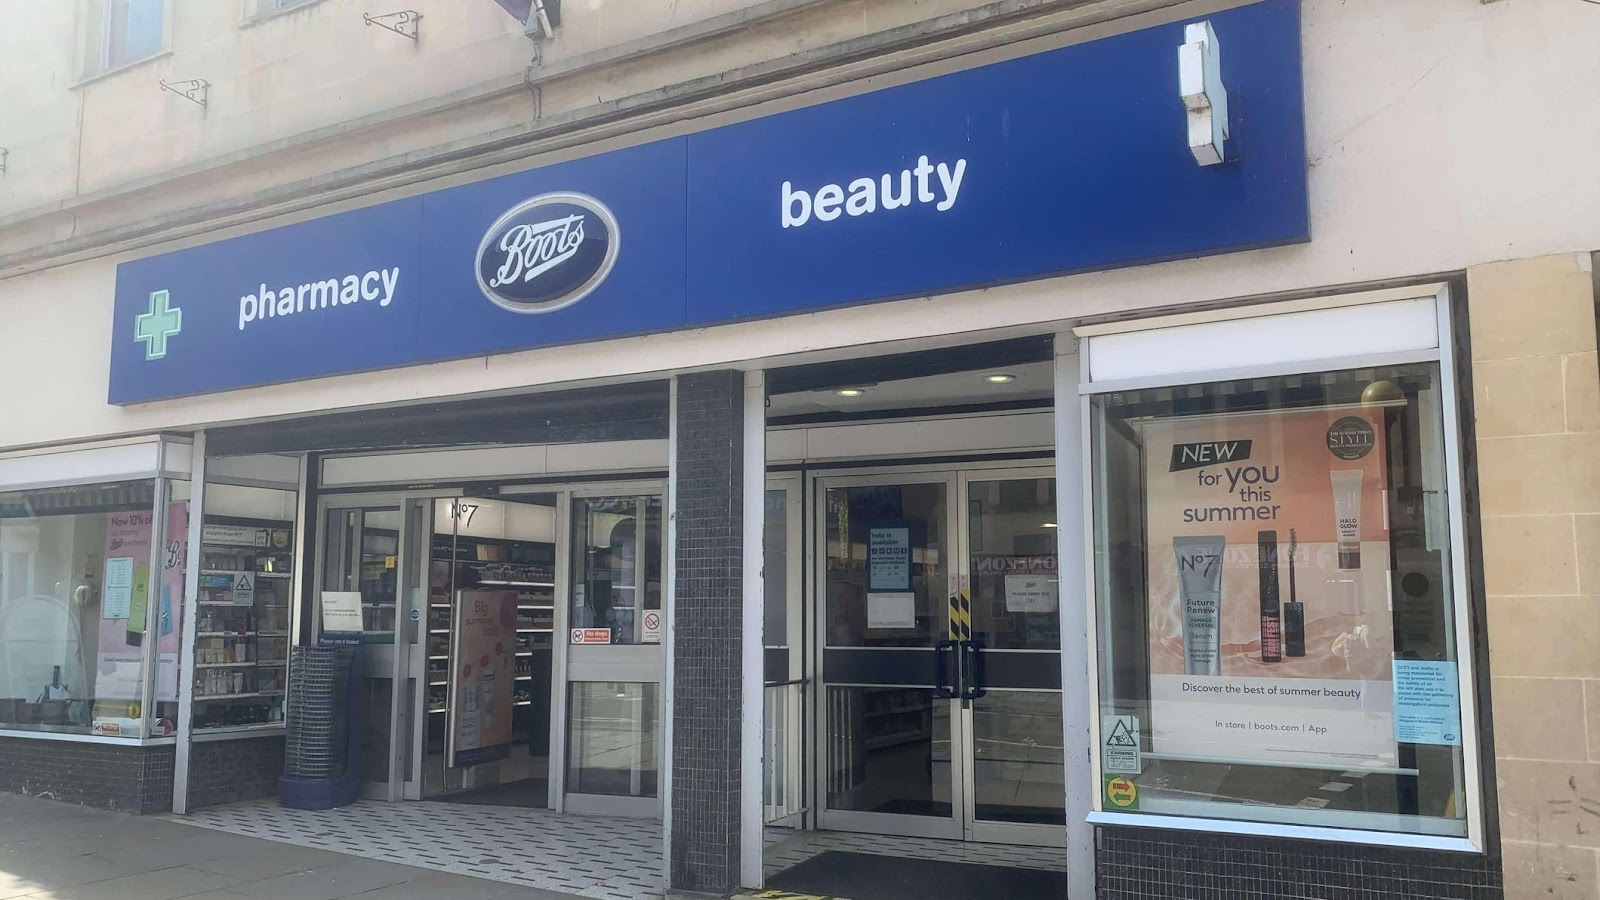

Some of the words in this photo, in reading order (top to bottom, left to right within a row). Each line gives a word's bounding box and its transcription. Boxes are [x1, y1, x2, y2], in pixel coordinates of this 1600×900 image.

[782, 155, 967, 229] beauty
[489, 214, 585, 288] Boots
[238, 267, 399, 330] pharmacy
[1182, 442, 1238, 462] NEW
[1198, 470, 1222, 486] for
[1225, 465, 1280, 493] you
[1240, 486, 1271, 502] this
[112, 516, 129, 526] Now
[129, 514, 143, 526] 10%
[1184, 506, 1281, 522] summer
[1182, 683, 1223, 693] Discover
[1225, 684, 1241, 694] the
[1243, 685, 1265, 695] best
[1267, 686, 1278, 695] of
[1280, 688, 1321, 696] summer
[1323, 688, 1361, 700] beauty
[1215, 720, 1223, 728] In
[1225, 721, 1246, 729] store
[1254, 724, 1299, 732] boots.com
[1308, 725, 1327, 734] App
